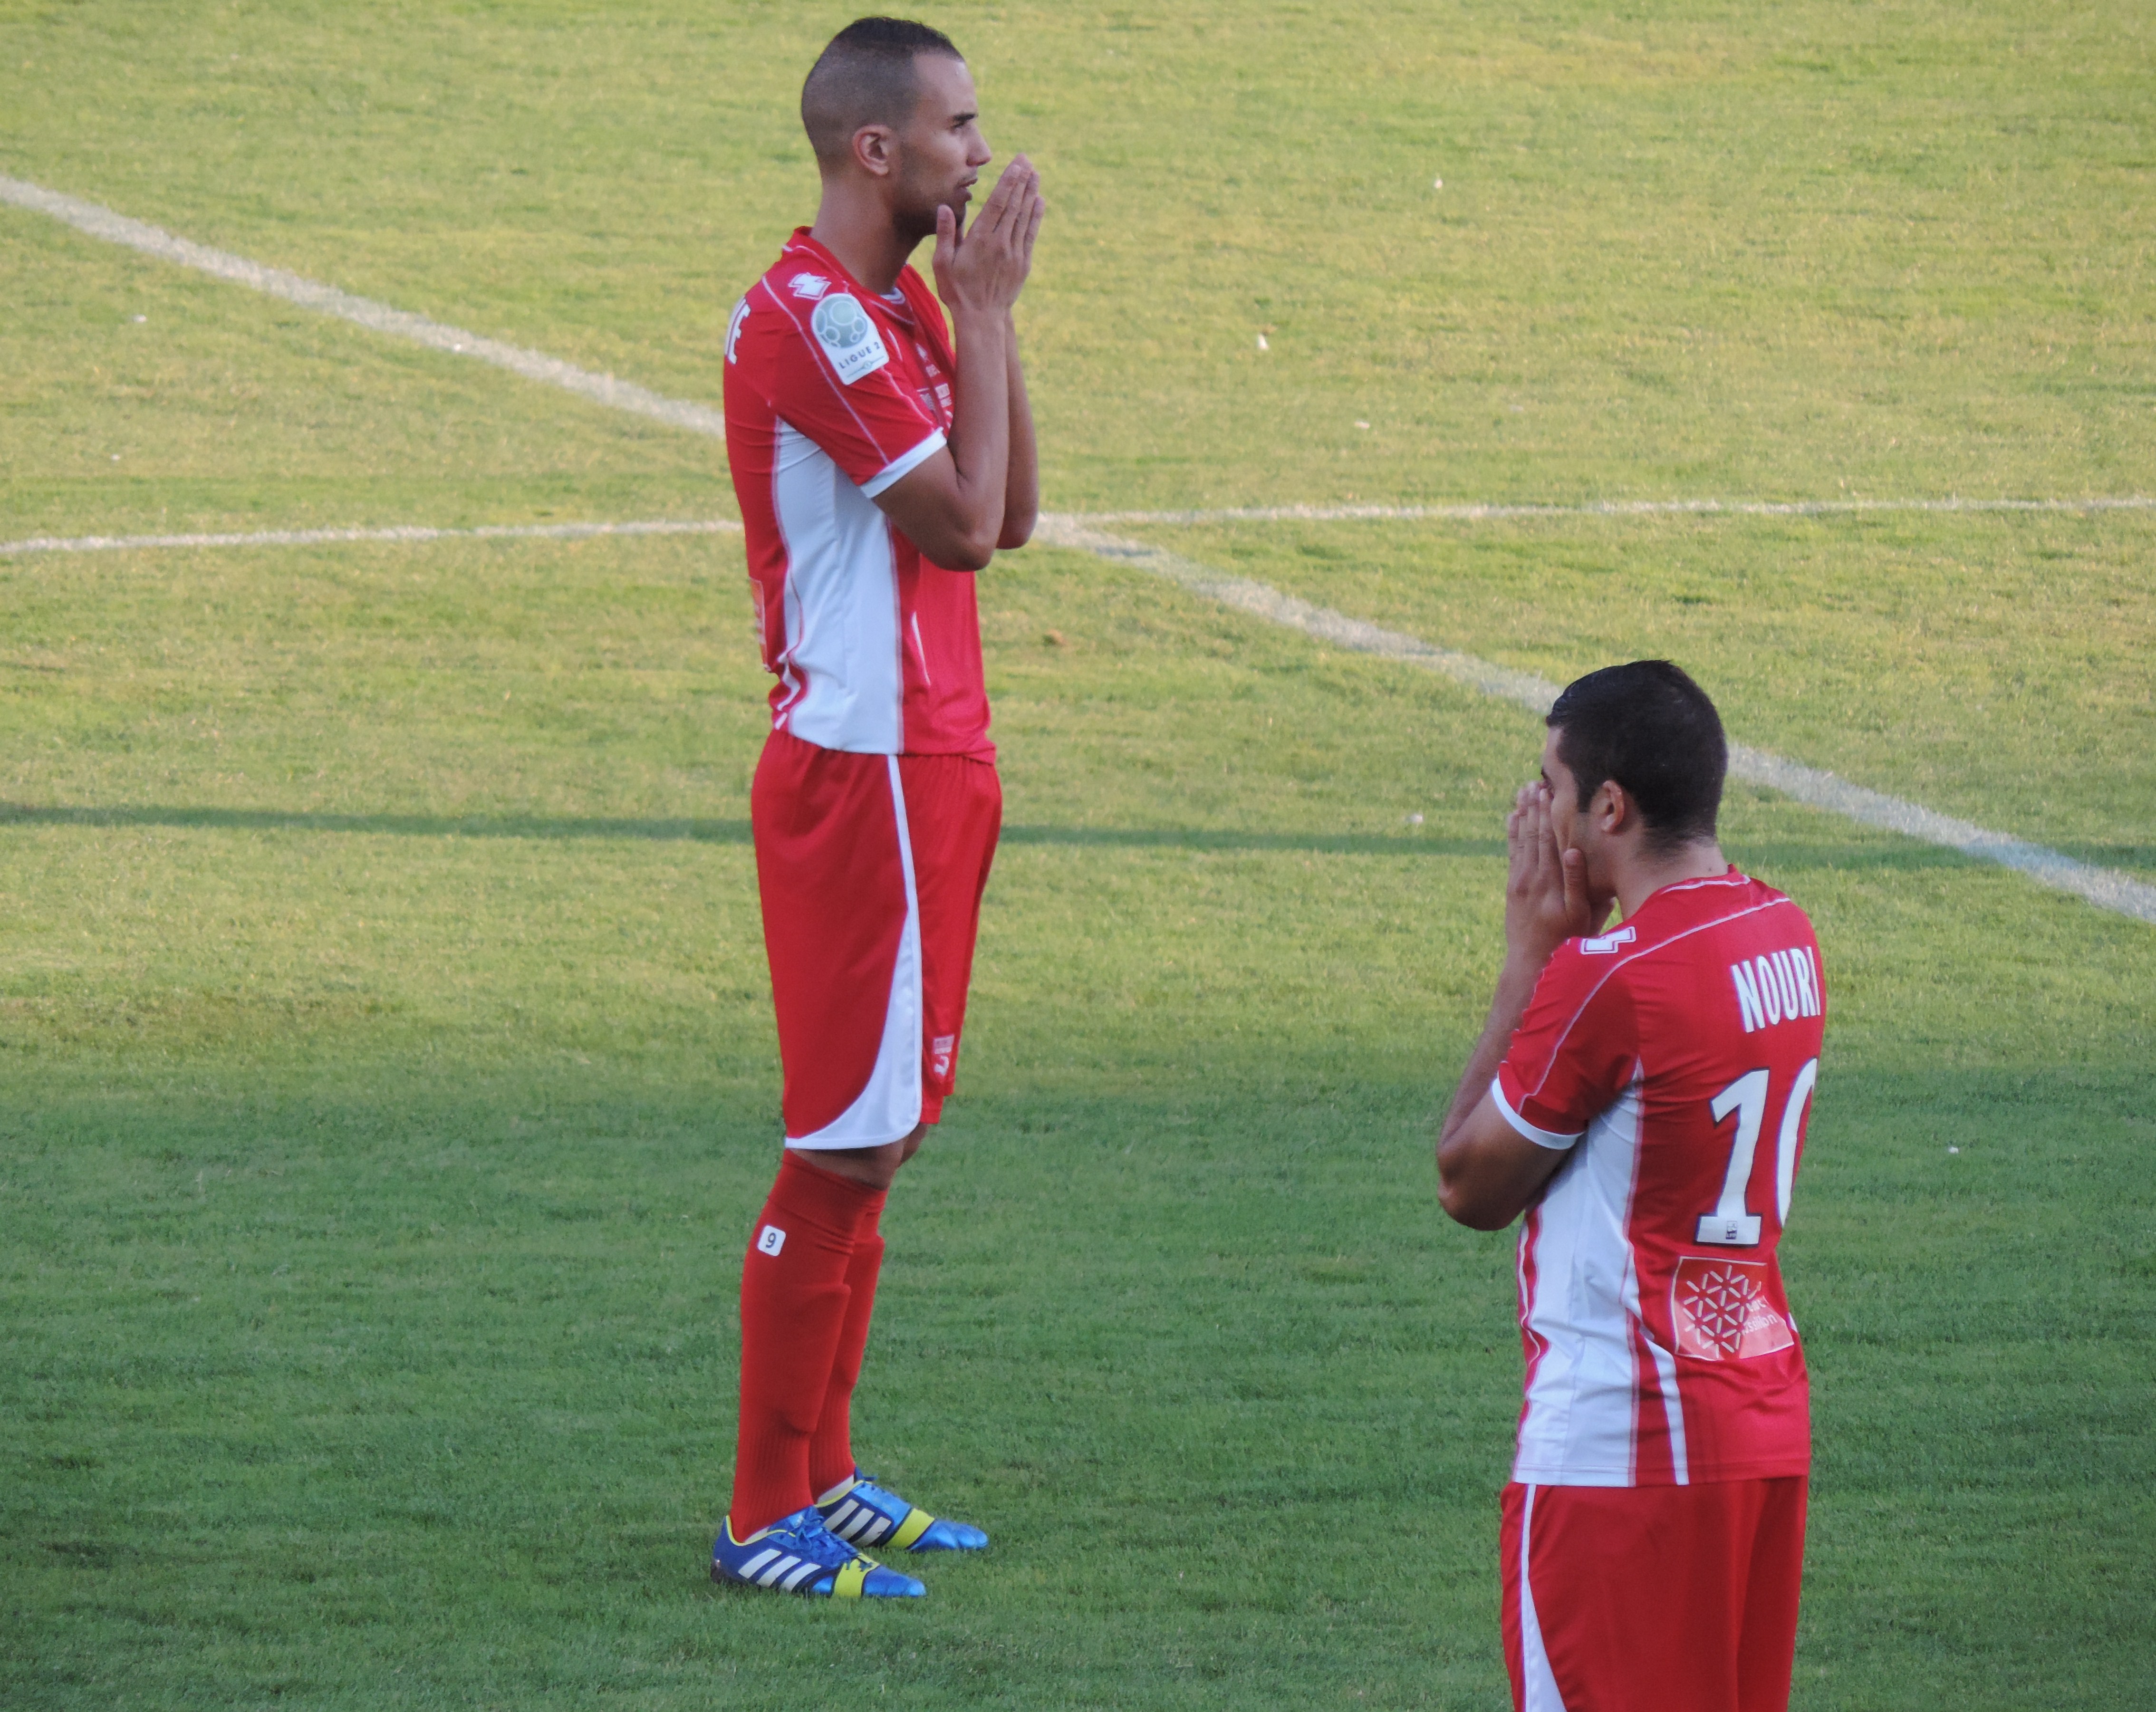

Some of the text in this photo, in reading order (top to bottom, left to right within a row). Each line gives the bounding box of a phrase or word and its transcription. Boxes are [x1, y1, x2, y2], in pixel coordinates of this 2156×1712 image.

[838, 341, 881, 369] LIGUE 2
[1731, 945, 1821, 1033] NOURI
[766, 1232, 777, 1249] 9
